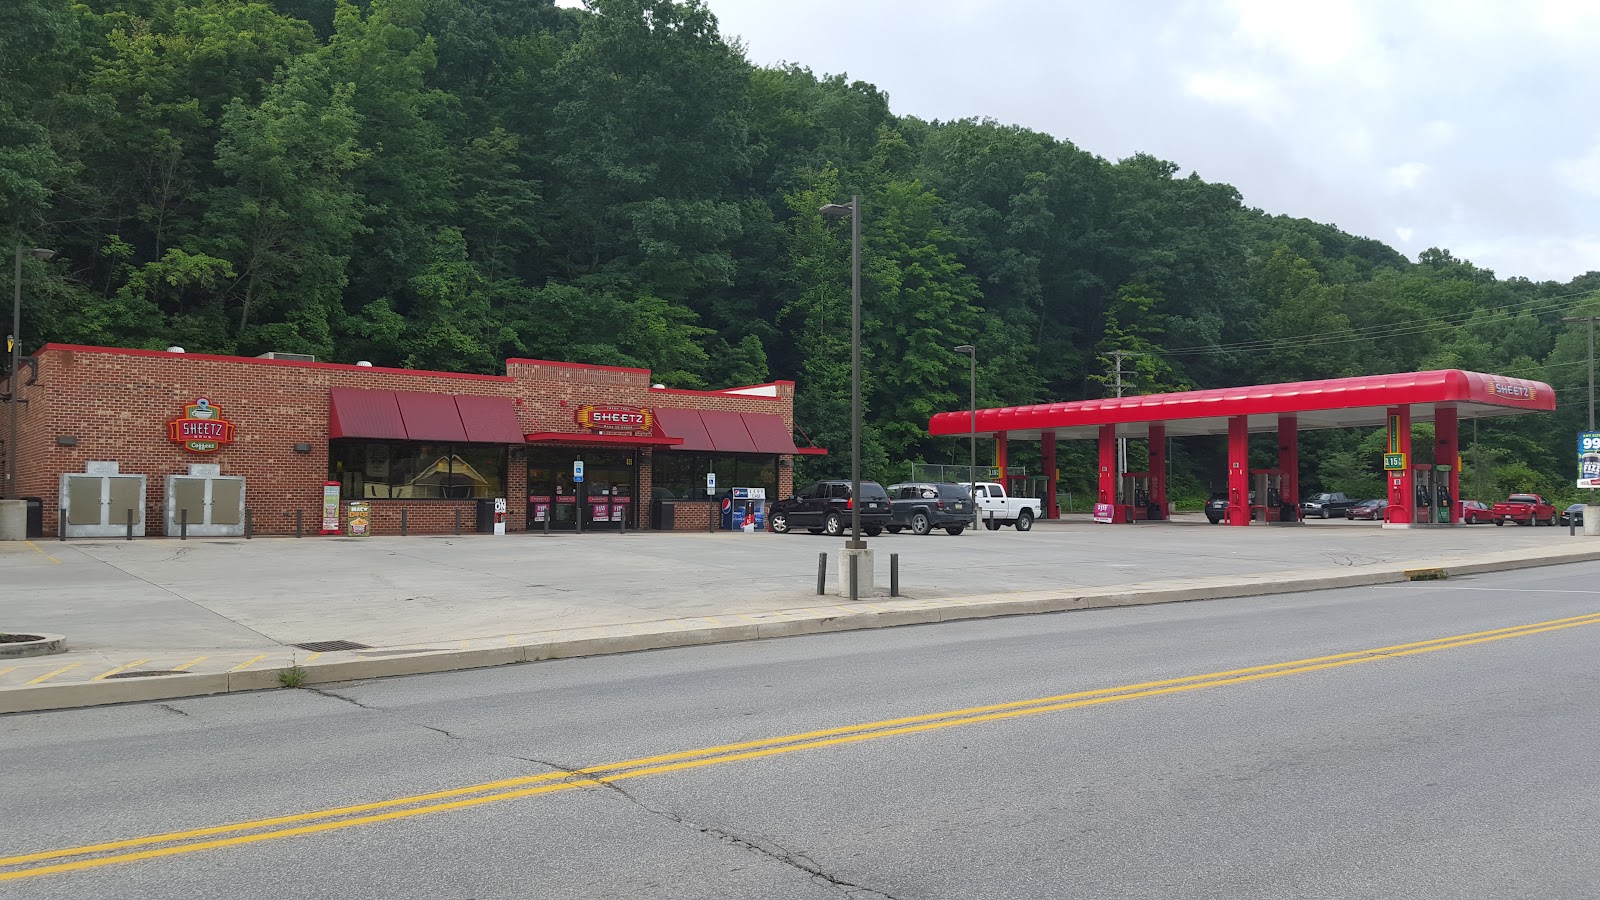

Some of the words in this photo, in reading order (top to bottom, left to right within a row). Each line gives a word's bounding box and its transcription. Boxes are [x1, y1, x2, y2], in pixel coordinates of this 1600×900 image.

[1495, 383, 1529, 397] SHEETZ
[593, 412, 643, 423] SHEETZ
[183, 422, 223, 436] SHEETZ
[495, 502, 506, 510] ON
